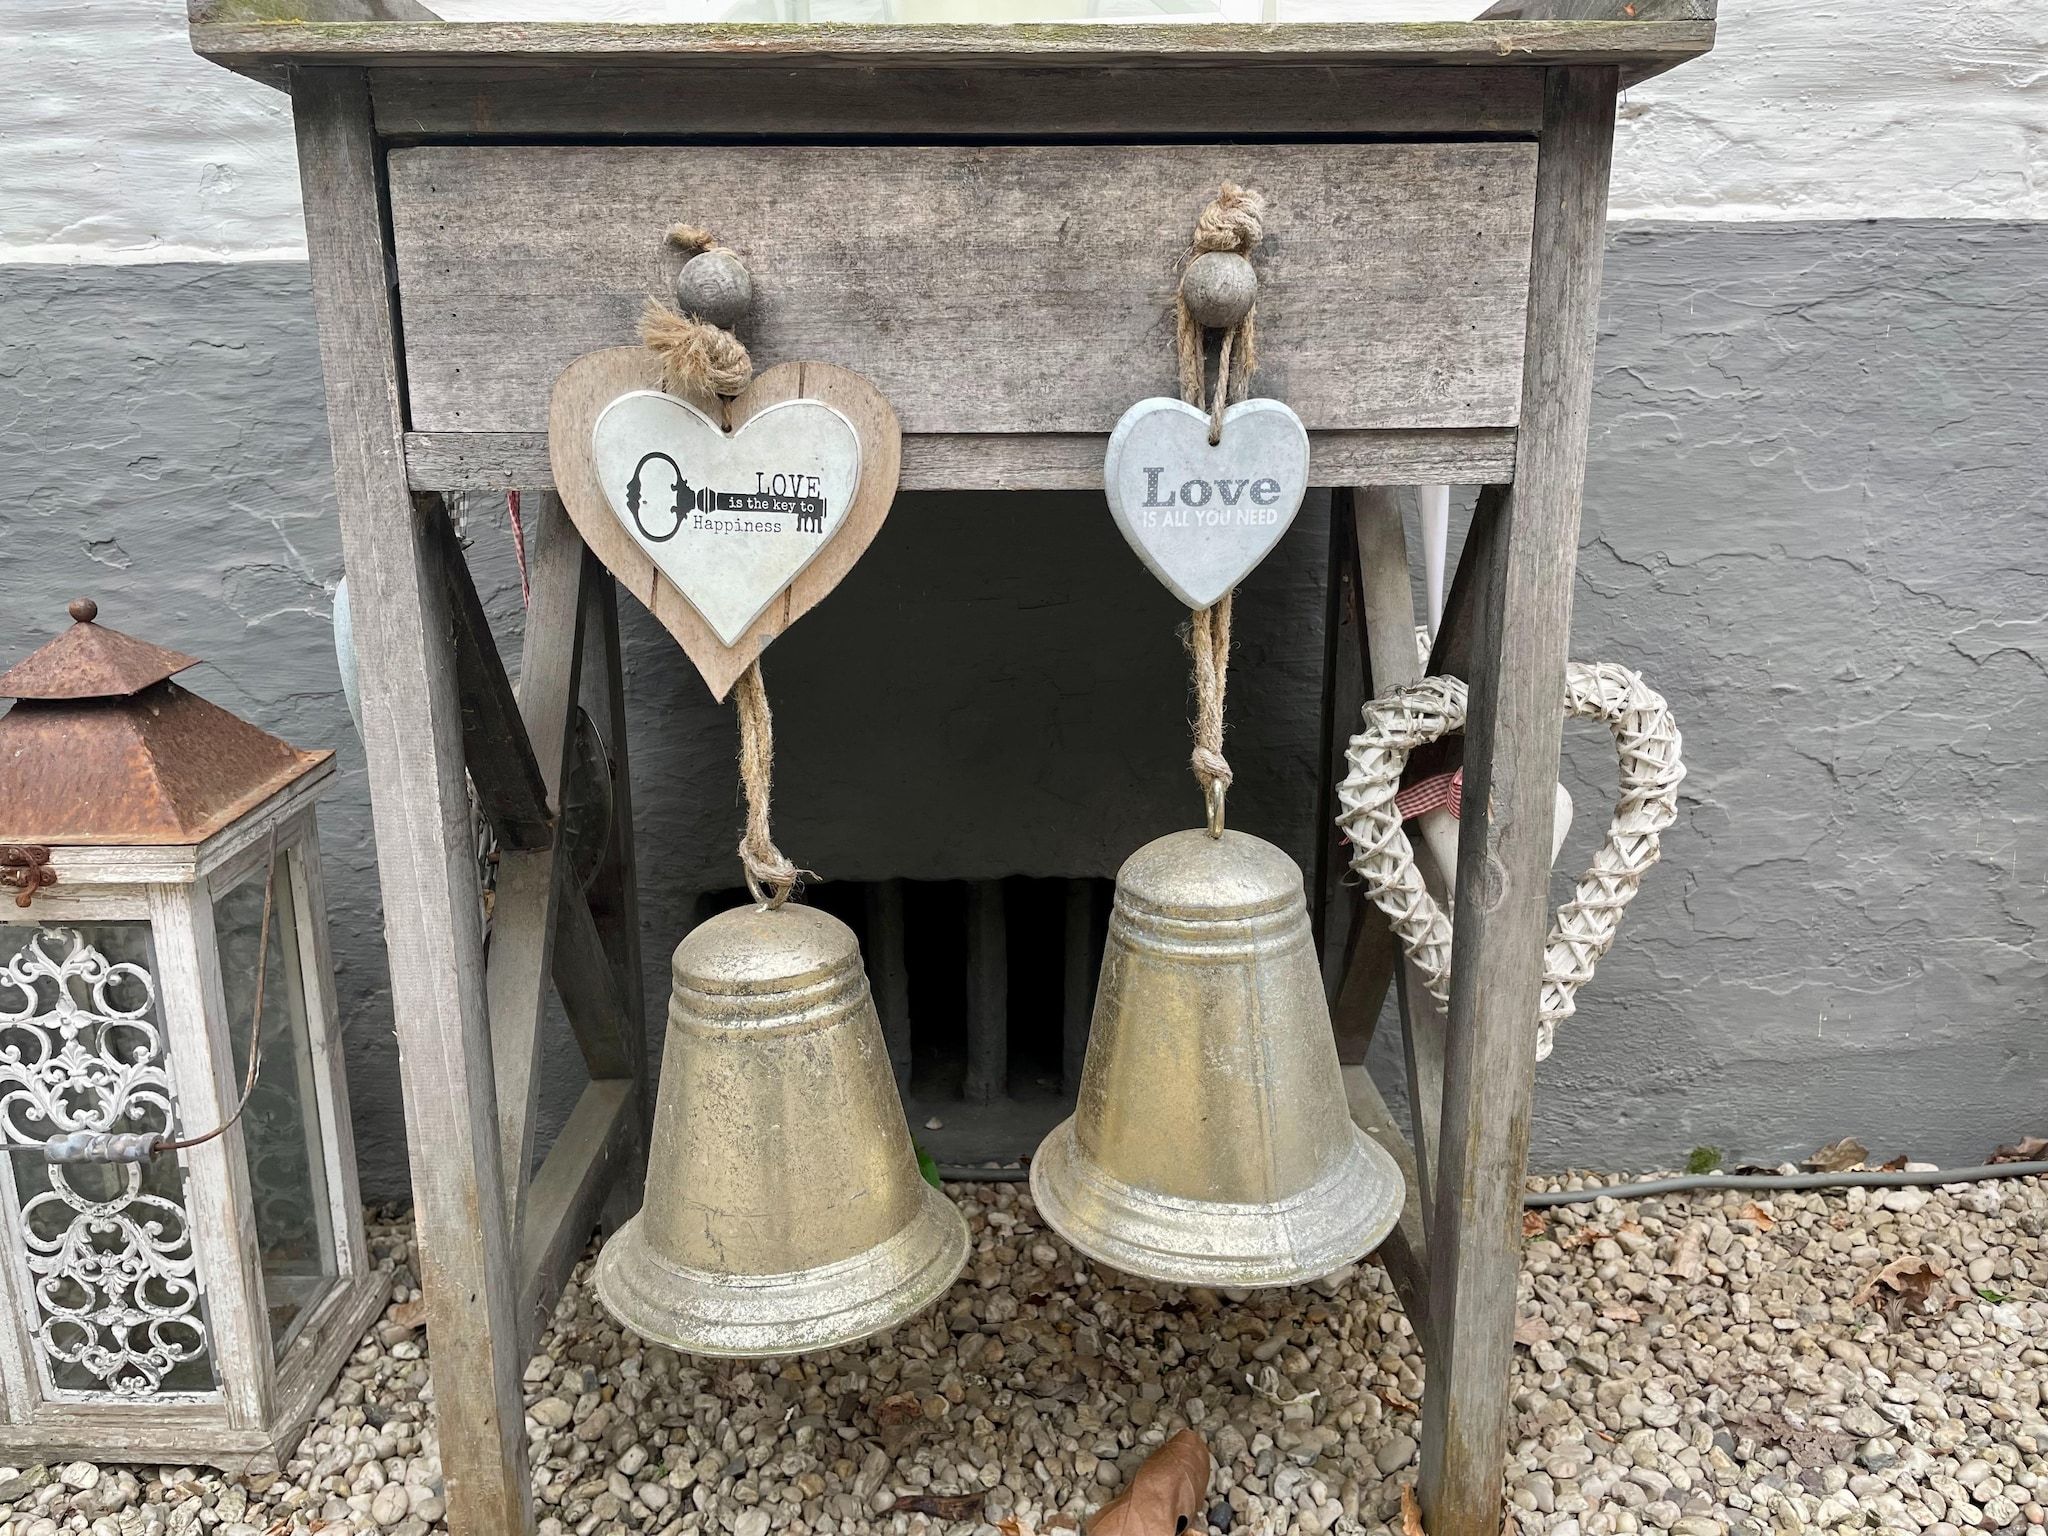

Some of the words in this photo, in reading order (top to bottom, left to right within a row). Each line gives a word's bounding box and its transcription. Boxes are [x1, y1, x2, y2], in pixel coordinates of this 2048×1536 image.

[755, 472, 821, 498] LOVE
[1142, 467, 1281, 508] Love
[728, 496, 743, 509] is
[747, 497, 769, 510] the
[772, 499, 795, 514] key
[800, 501, 815, 513] to
[693, 515, 782, 535] Happiness
[1143, 511, 1157, 528] IS
[1162, 511, 1190, 527] ALL
[1195, 509, 1231, 527] YOU
[1236, 509, 1278, 526] NEED
